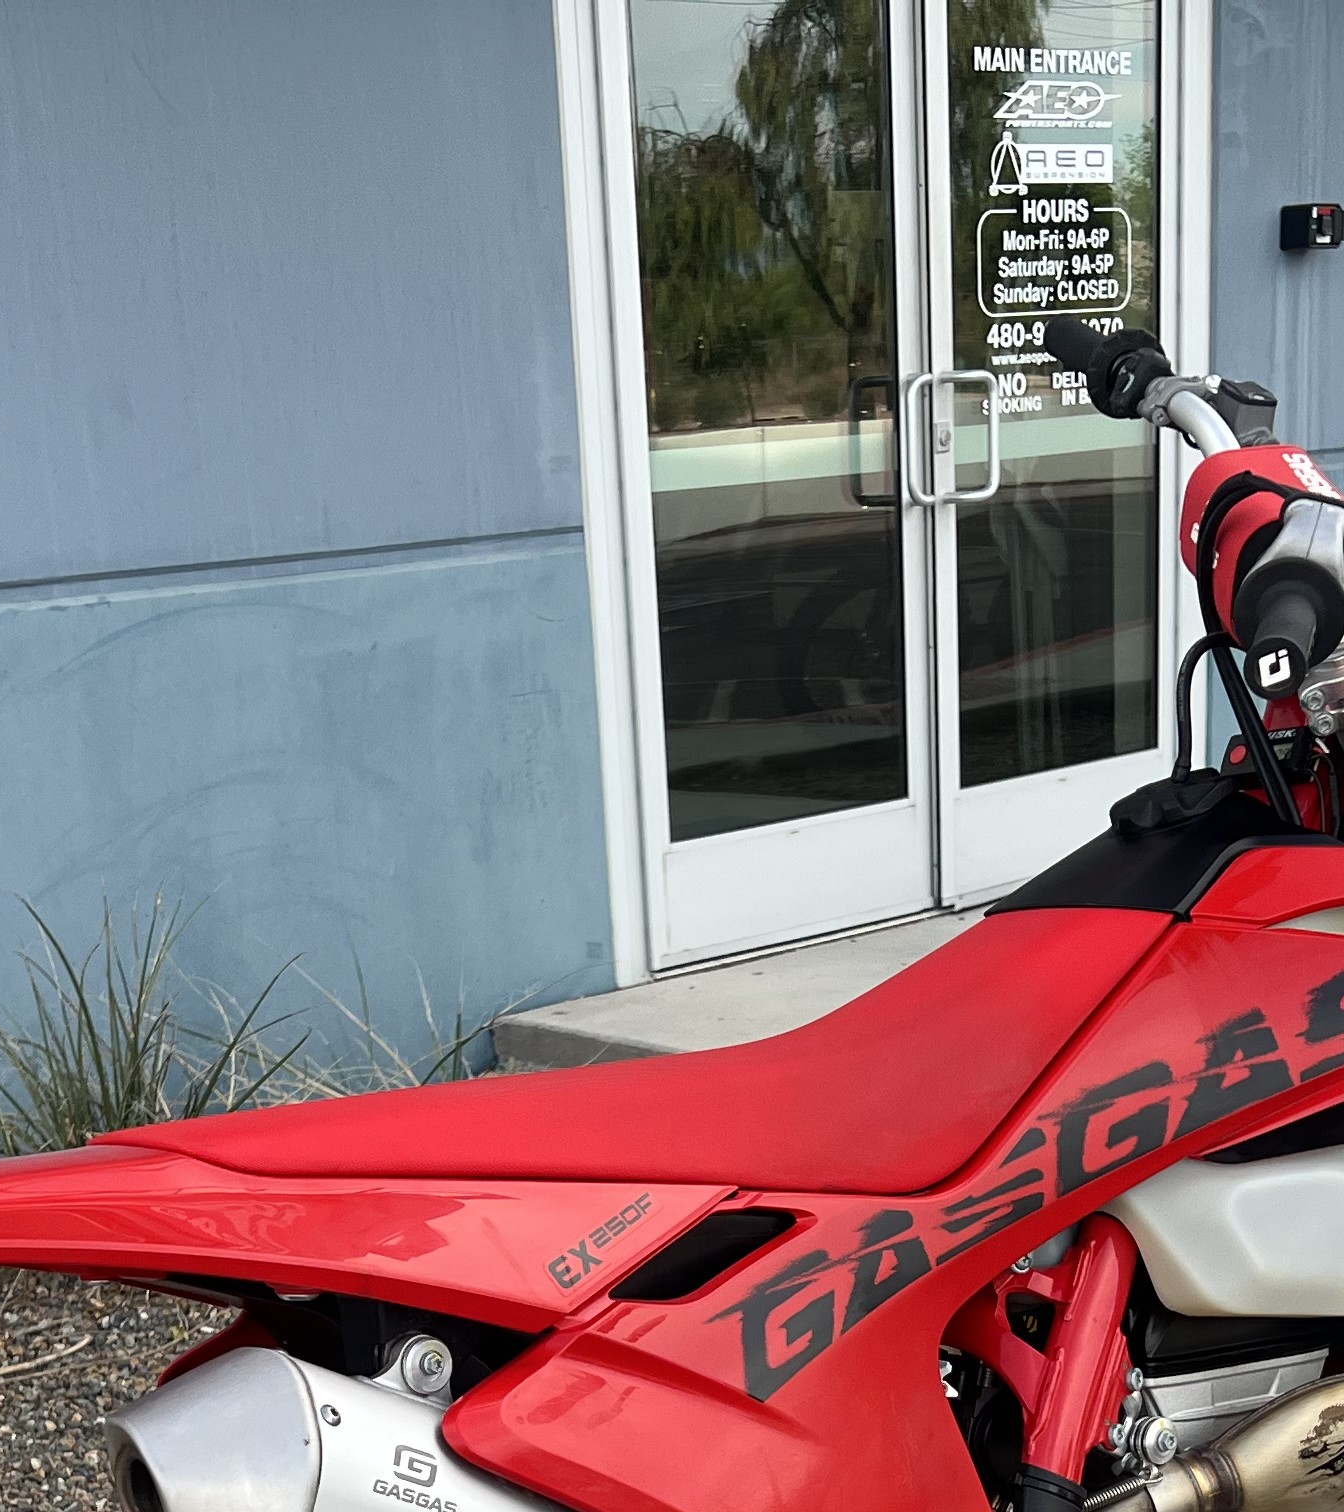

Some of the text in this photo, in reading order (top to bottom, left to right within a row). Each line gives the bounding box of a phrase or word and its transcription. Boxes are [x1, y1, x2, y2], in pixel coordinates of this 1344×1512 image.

[974, 46, 1132, 75] MAIN ENTRANCE
[1026, 150, 1105, 168] AEO
[1022, 198, 1090, 223] HOURS
[1002, 227, 1110, 251] Mon-Fri: 9A-6P
[998, 253, 1114, 281] Saturday: 9A-5P
[993, 279, 1119, 307] Sunday: CLOSED
[998, 372, 1027, 397] NO
[982, 396, 1042, 415] SOKING
[1061, 388, 1076, 406] IN
[548, 1192, 652, 1289] EX 250F
